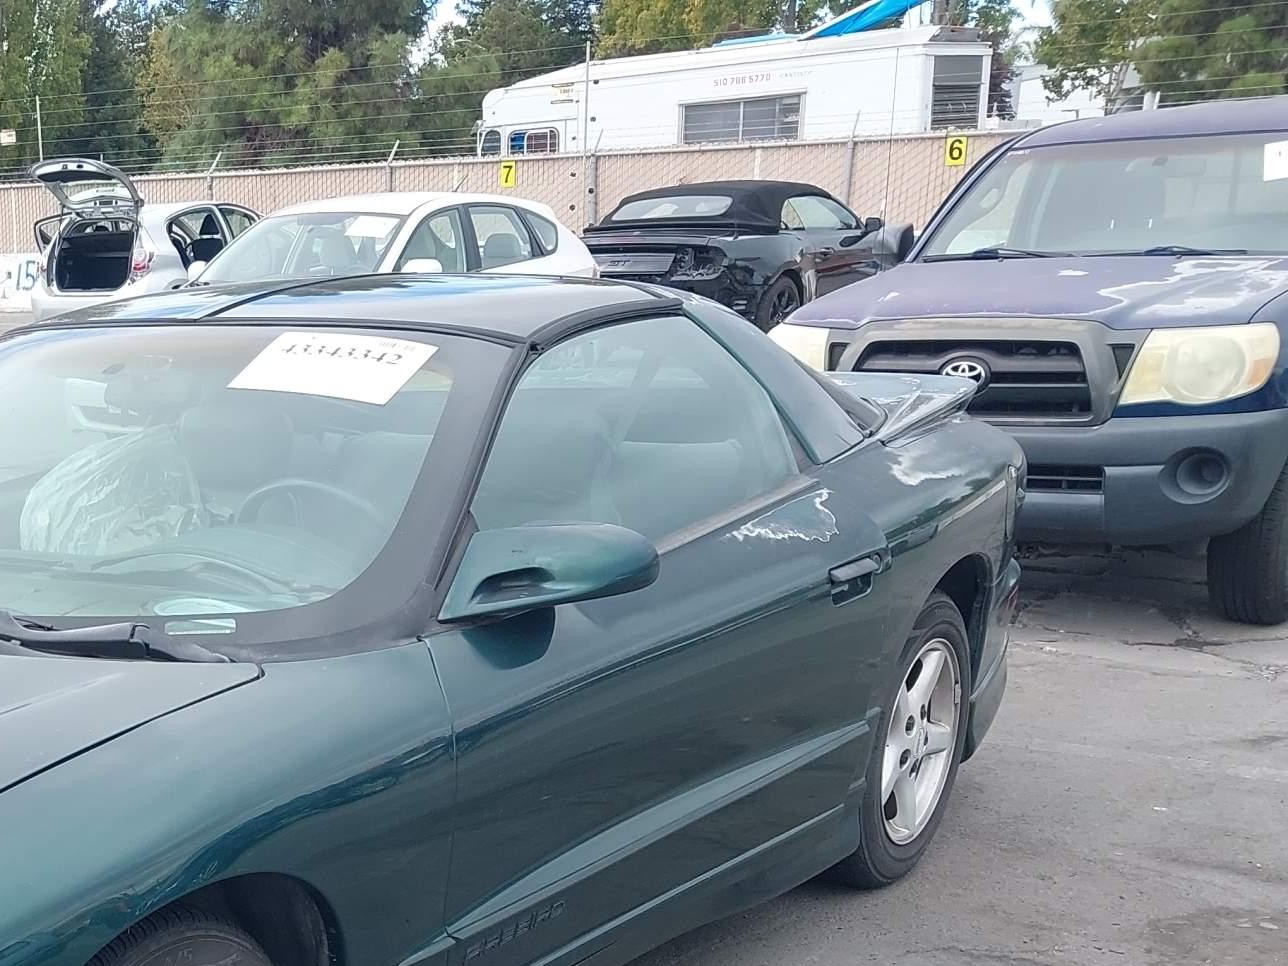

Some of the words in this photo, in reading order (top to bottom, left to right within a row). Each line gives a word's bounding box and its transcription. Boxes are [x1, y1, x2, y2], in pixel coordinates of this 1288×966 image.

[949, 138, 963, 161] 6
[502, 165, 513, 183] 7
[281, 344, 403, 364] 43343342
